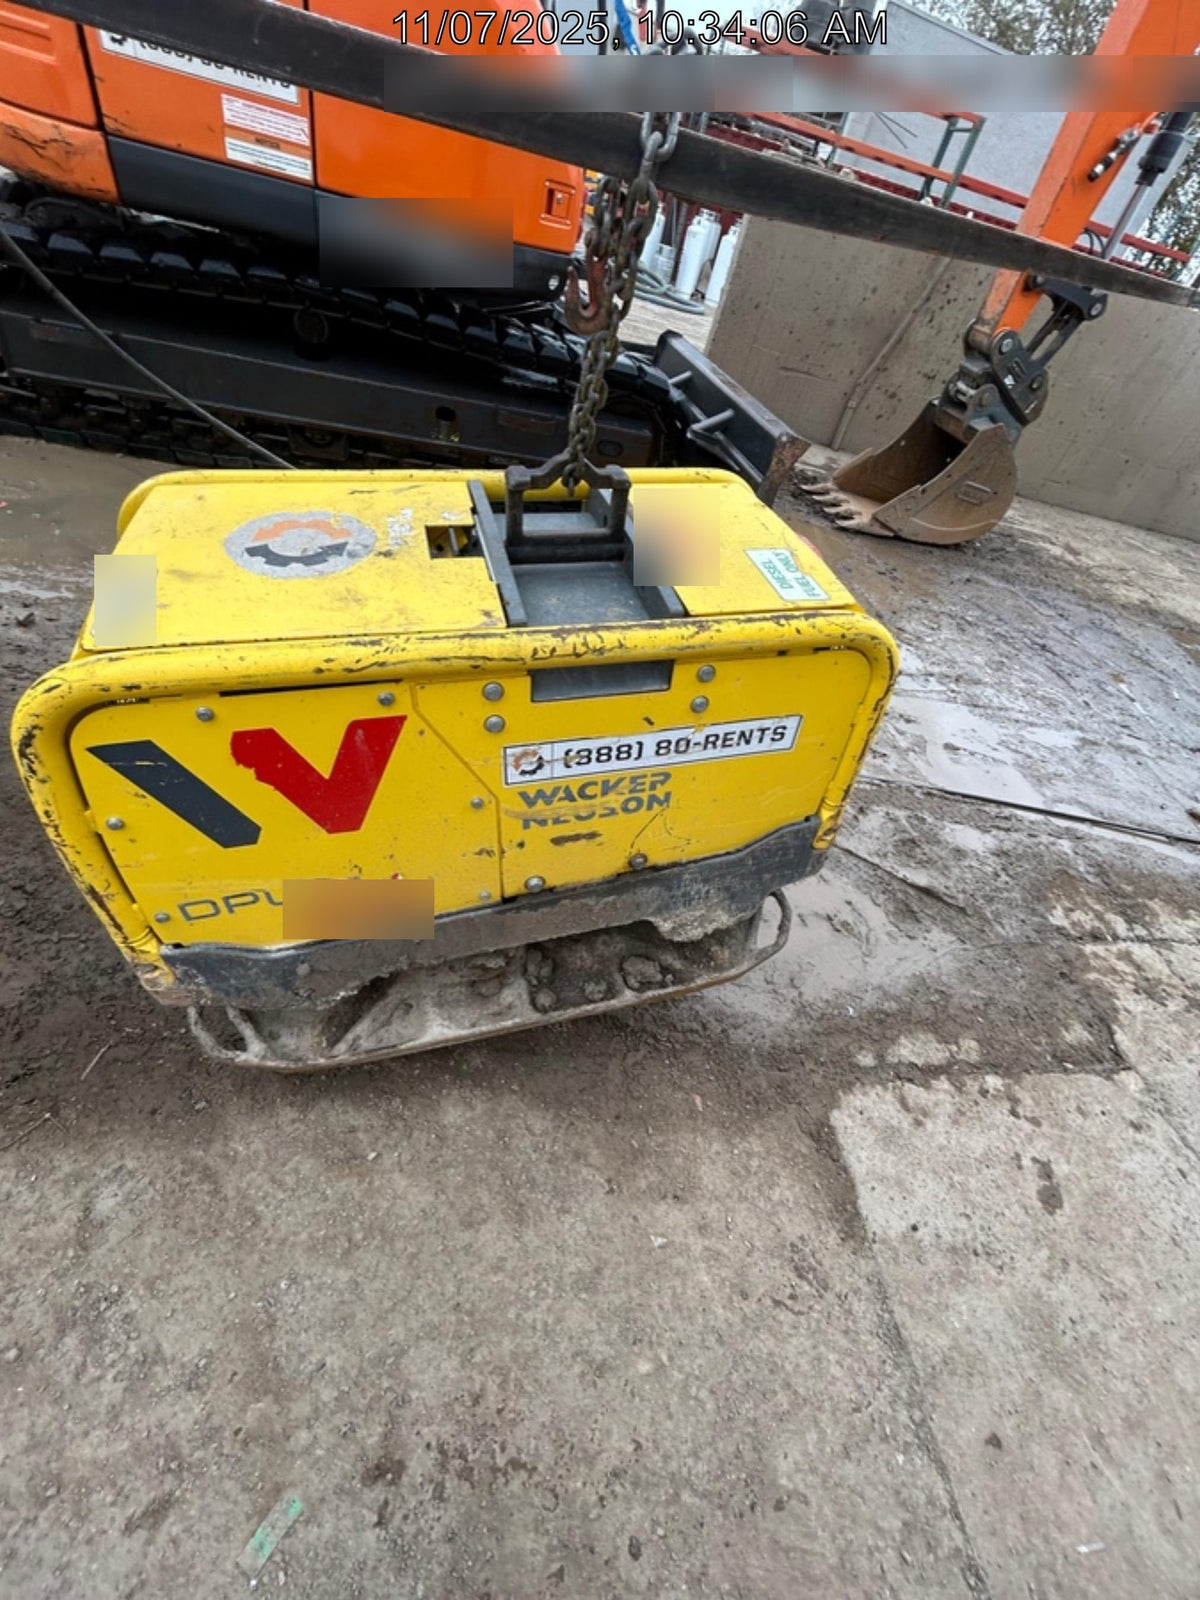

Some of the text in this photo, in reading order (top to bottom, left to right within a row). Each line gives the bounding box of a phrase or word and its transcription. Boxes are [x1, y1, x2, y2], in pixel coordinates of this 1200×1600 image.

[761, 560, 795, 589] DIESEL
[772, 551, 821, 597] FUEL ONLY
[563, 724, 788, 769] (888) 80-RENTS
[518, 771, 672, 809] WACKER
